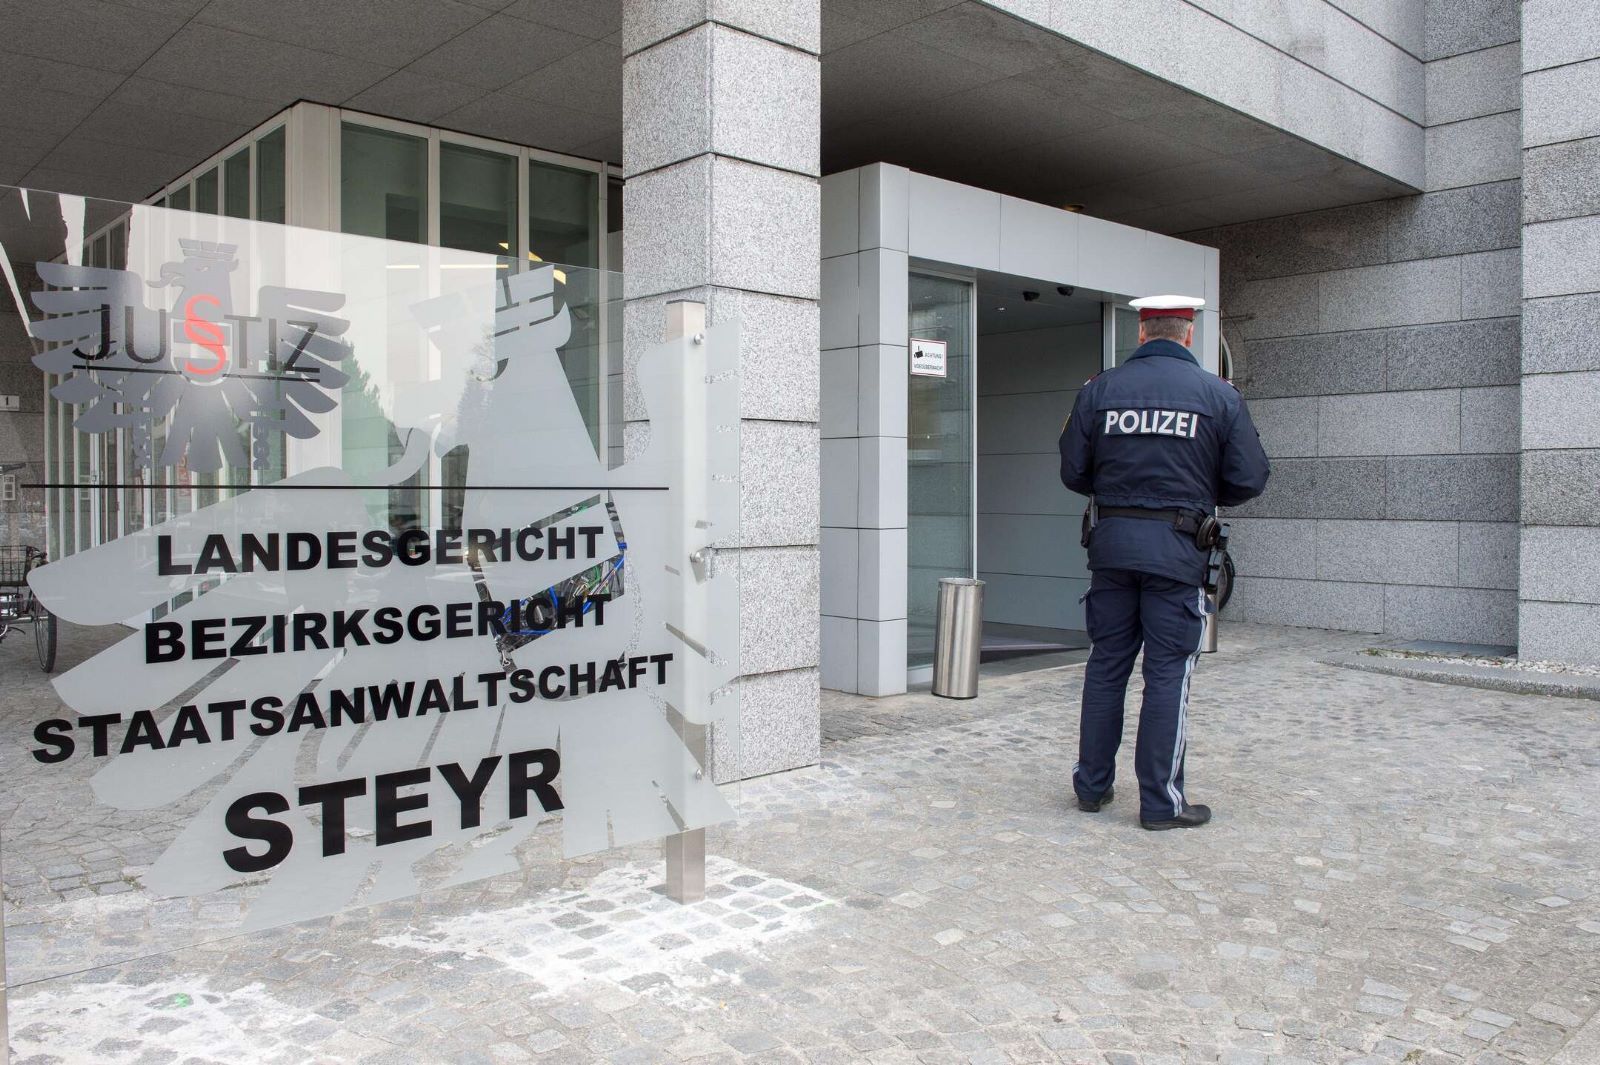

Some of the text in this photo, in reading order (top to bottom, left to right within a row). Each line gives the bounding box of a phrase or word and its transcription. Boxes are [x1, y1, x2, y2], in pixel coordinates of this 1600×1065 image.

[1104, 409, 1199, 438] POLIZEI
[157, 526, 605, 577] LANDESGERICHT
[145, 592, 612, 665] BEZIRKSGERICHT
[32, 653, 674, 764] STAATSANWALTSCHAFT
[222, 748, 565, 874] STEYR
